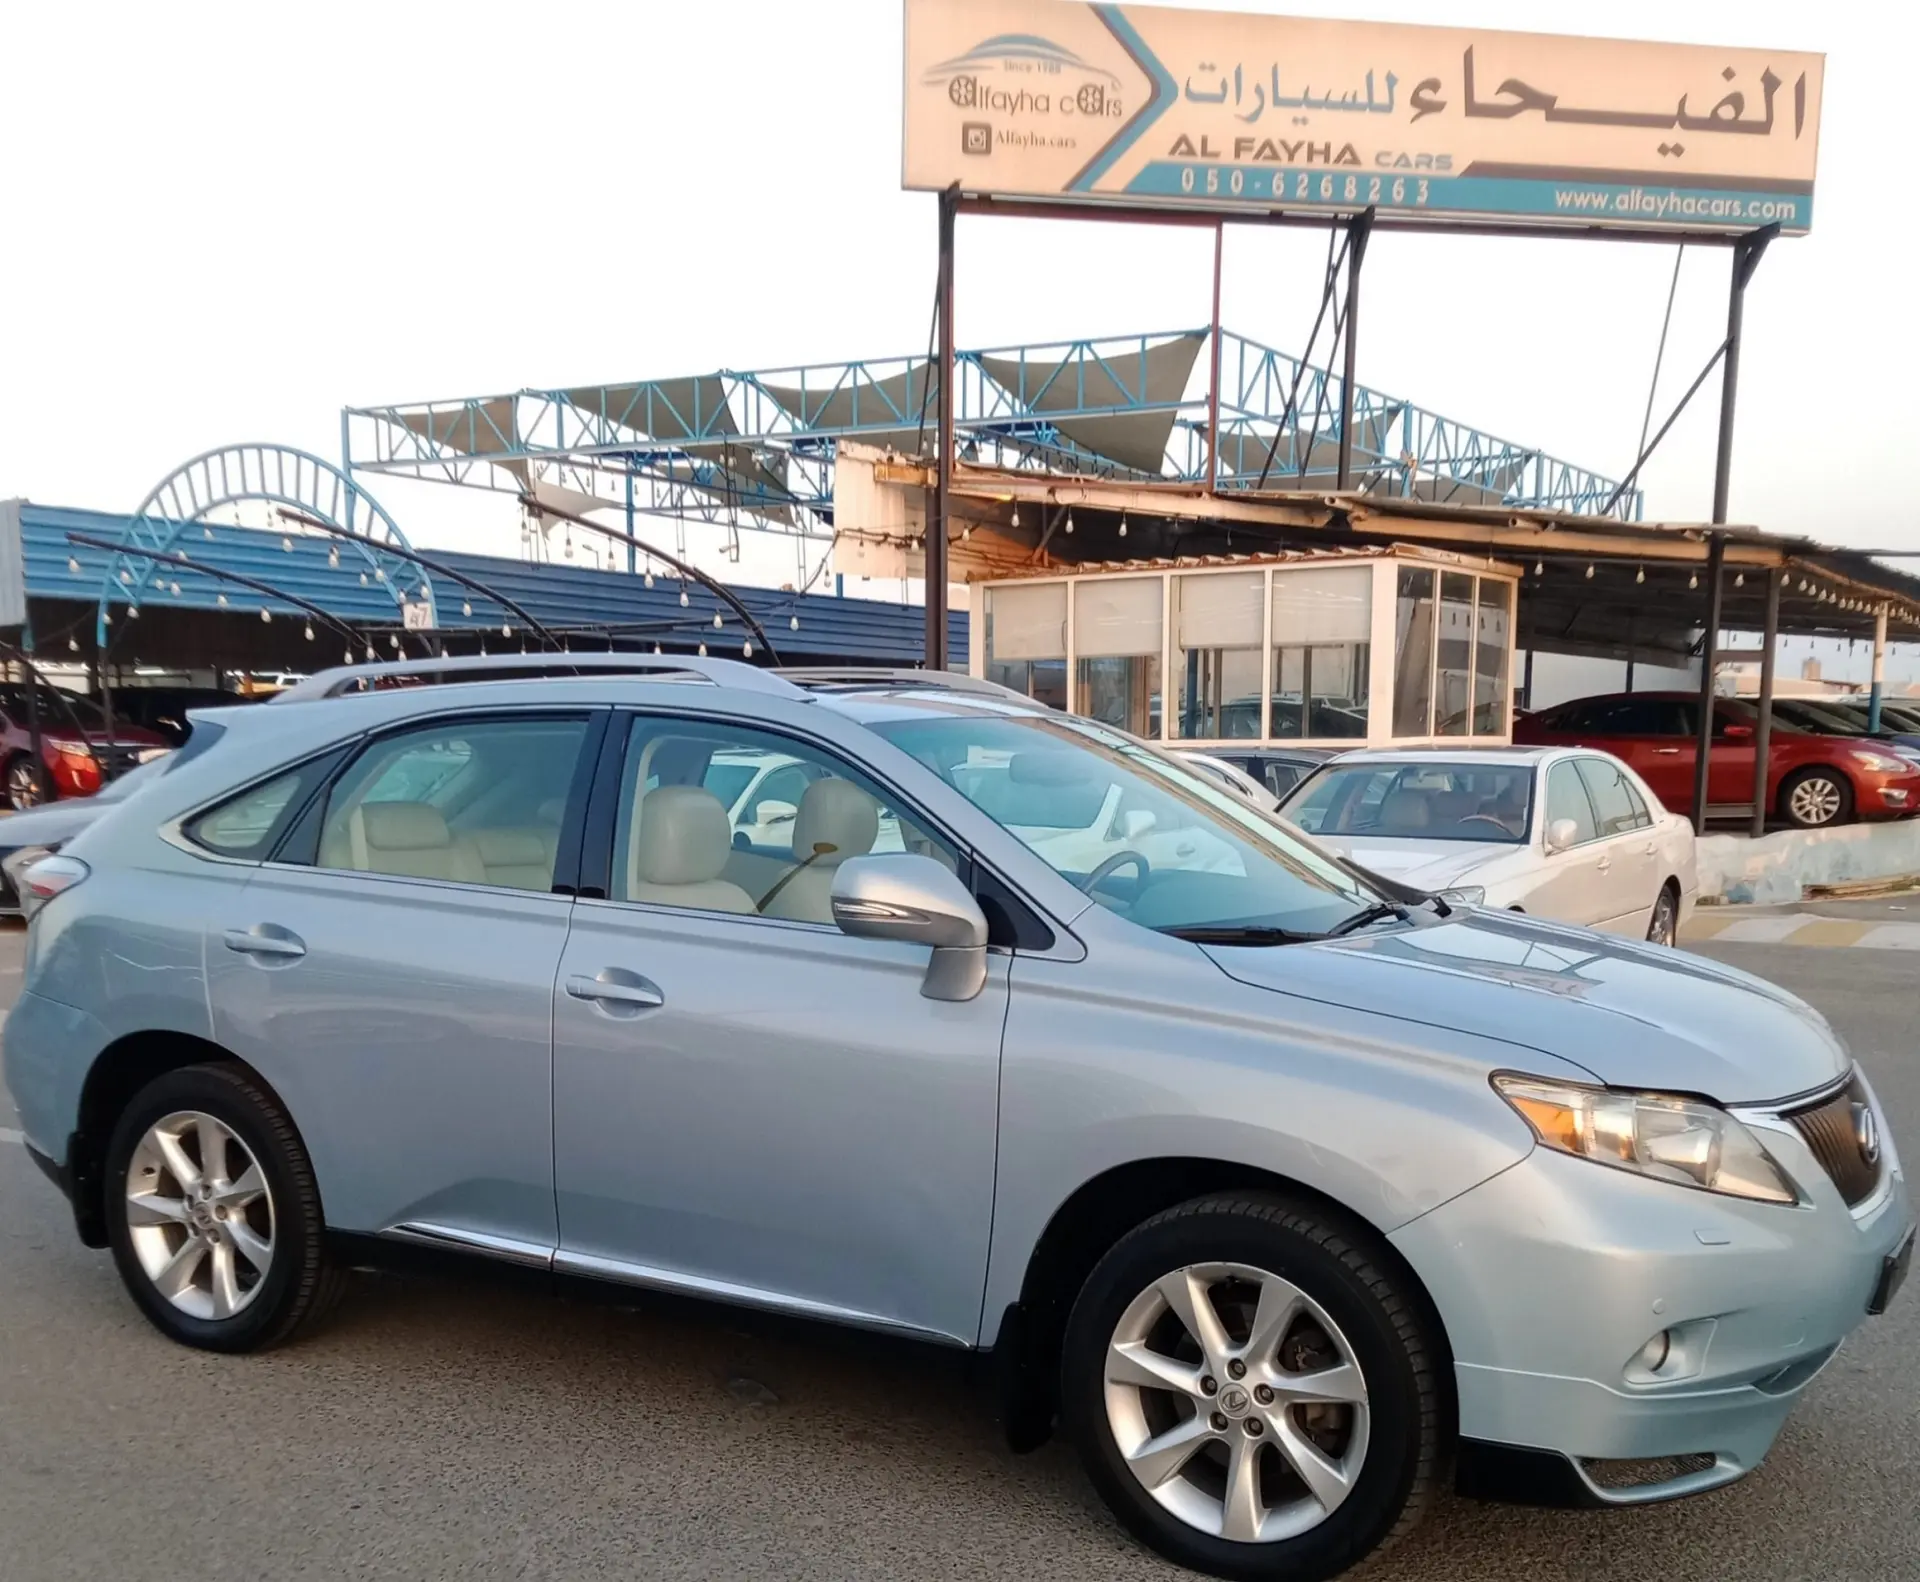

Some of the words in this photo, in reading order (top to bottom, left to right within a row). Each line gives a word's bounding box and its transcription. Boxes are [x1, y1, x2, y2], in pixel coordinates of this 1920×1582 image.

[1184, 61, 1398, 125] للسيارات
[1409, 43, 1806, 158] الفيحاء
[1168, 133, 1221, 158] AL
[1234, 136, 1362, 166] FAYHA
[1374, 150, 1453, 171] CARS
[1556, 189, 1796, 219] www.alfayhacars.com
